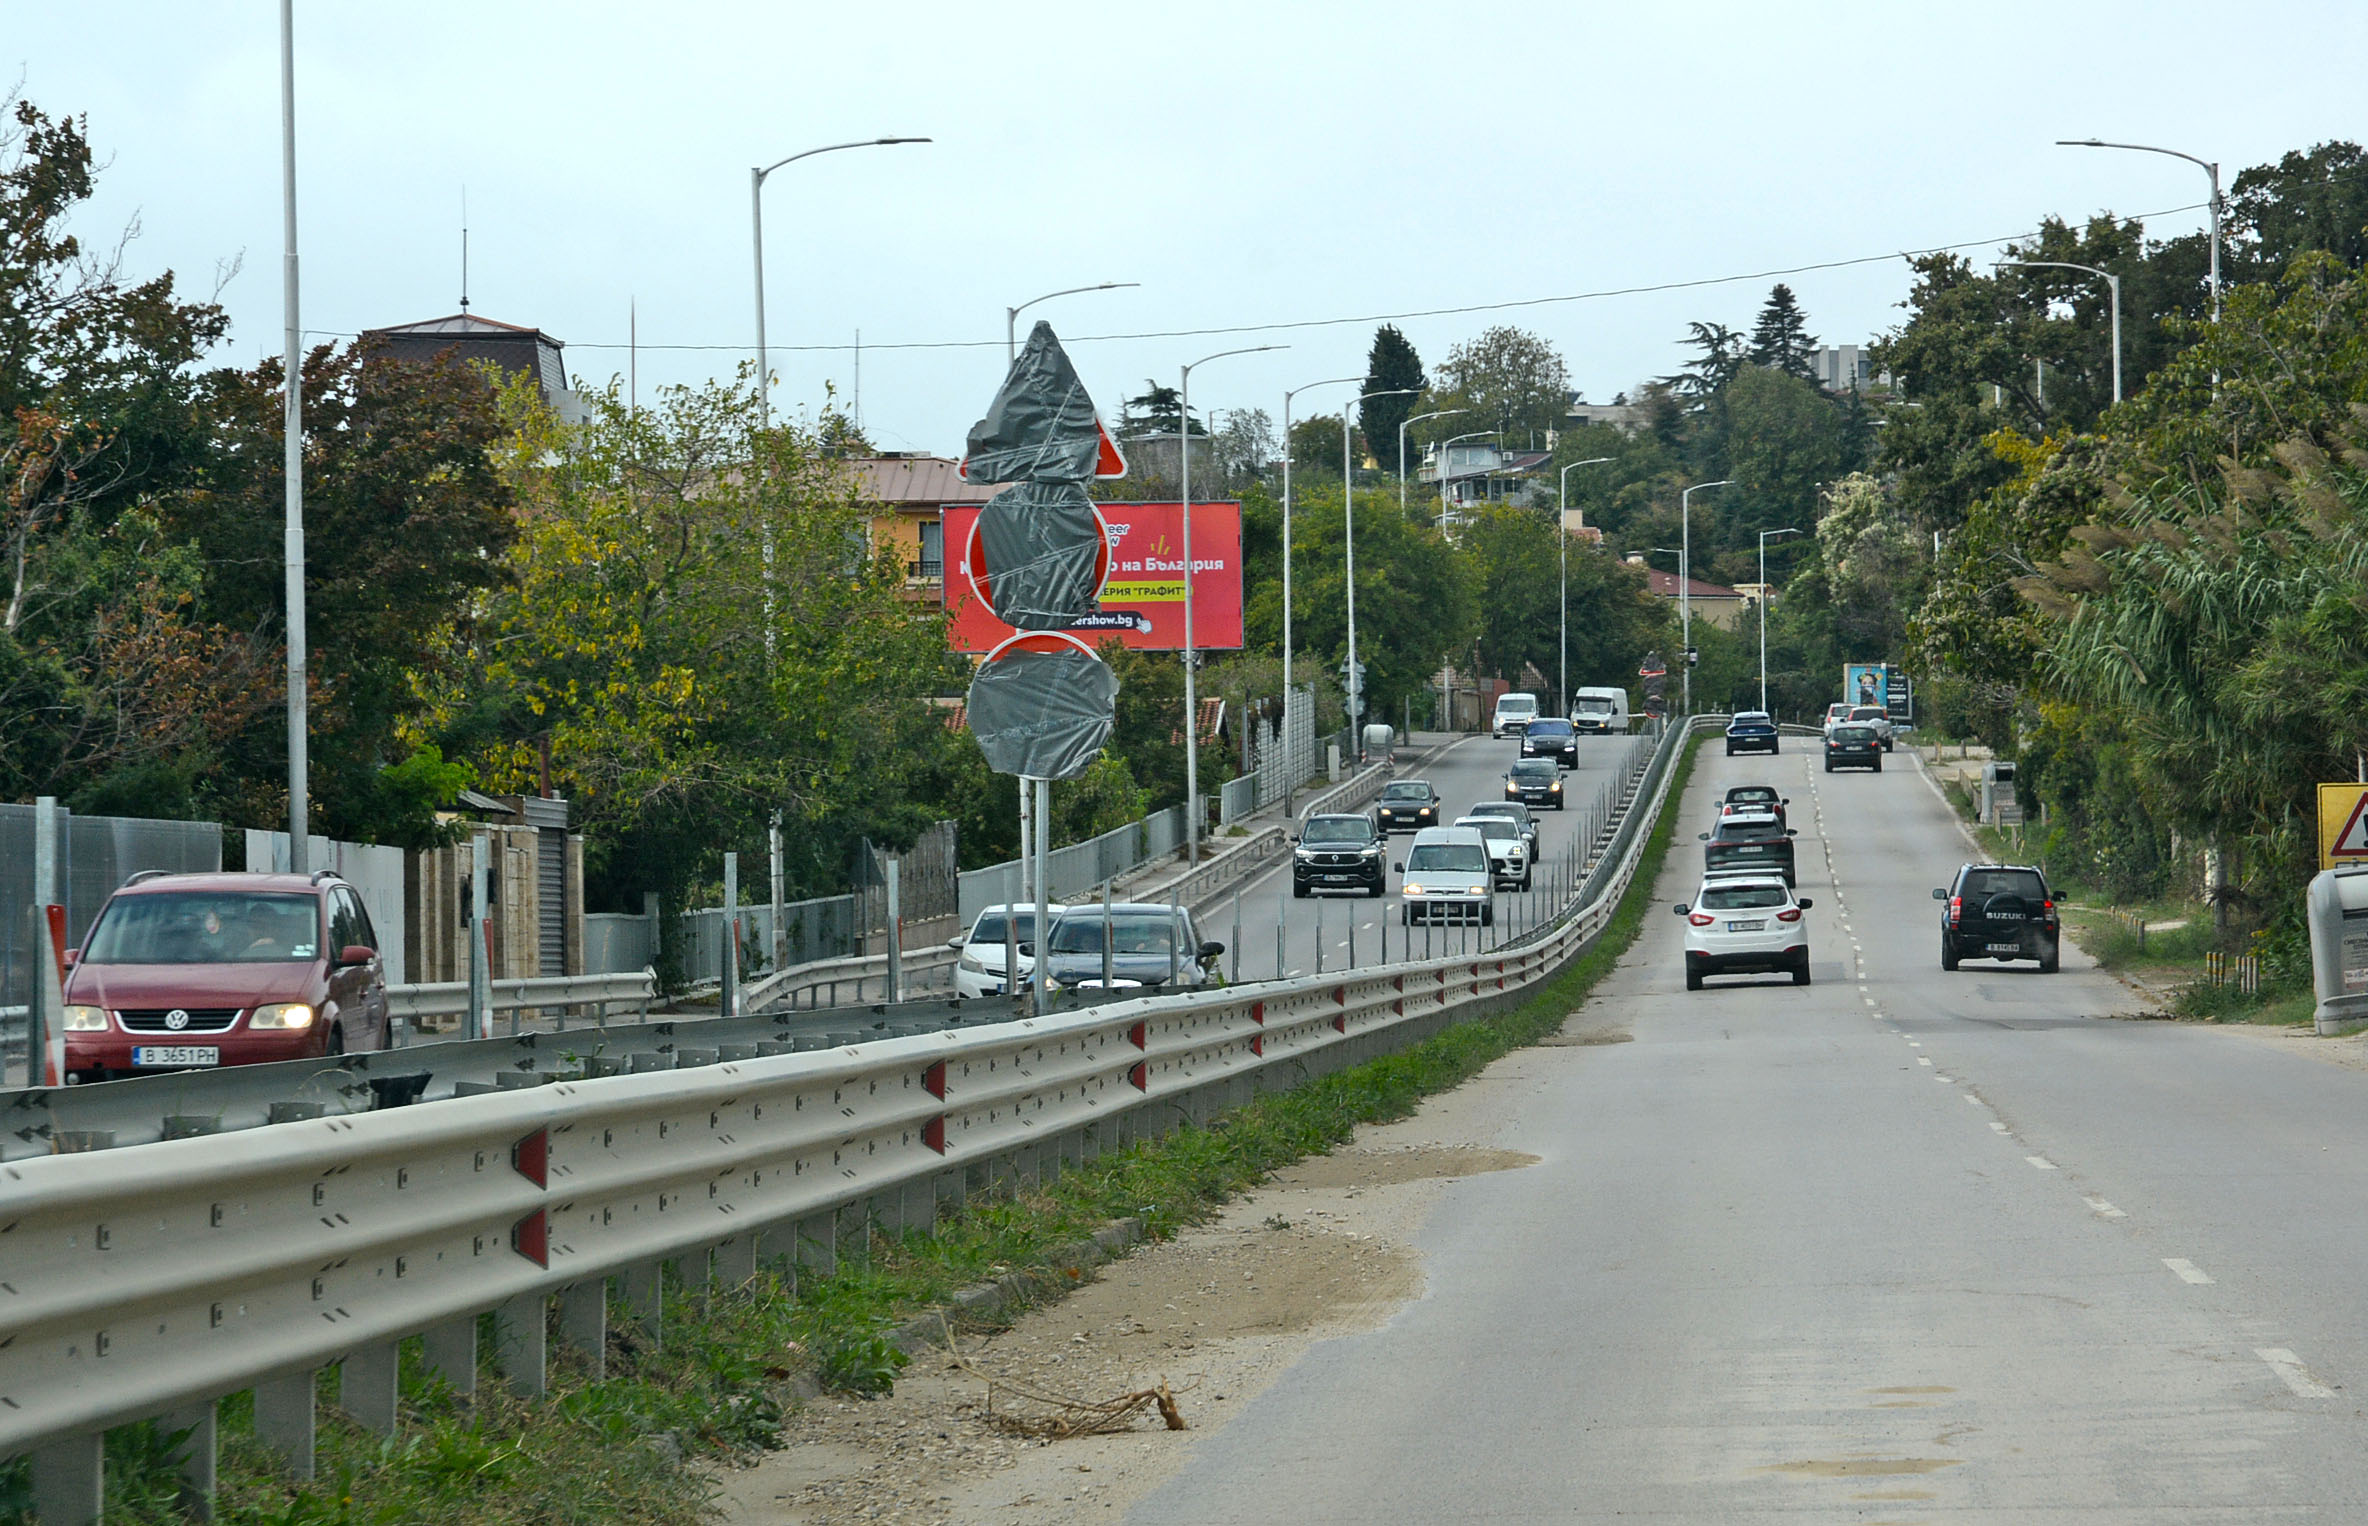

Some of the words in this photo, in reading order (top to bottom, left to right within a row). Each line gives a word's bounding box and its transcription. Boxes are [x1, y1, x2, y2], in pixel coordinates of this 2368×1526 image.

[1107, 525, 1129, 534] eer
[1122, 561, 1141, 572] на
[1145, 557, 1224, 574] Бългрия
[1102, 587, 1131, 596] ЕРИЯ
[1986, 912, 2026, 920] SUZUKI
